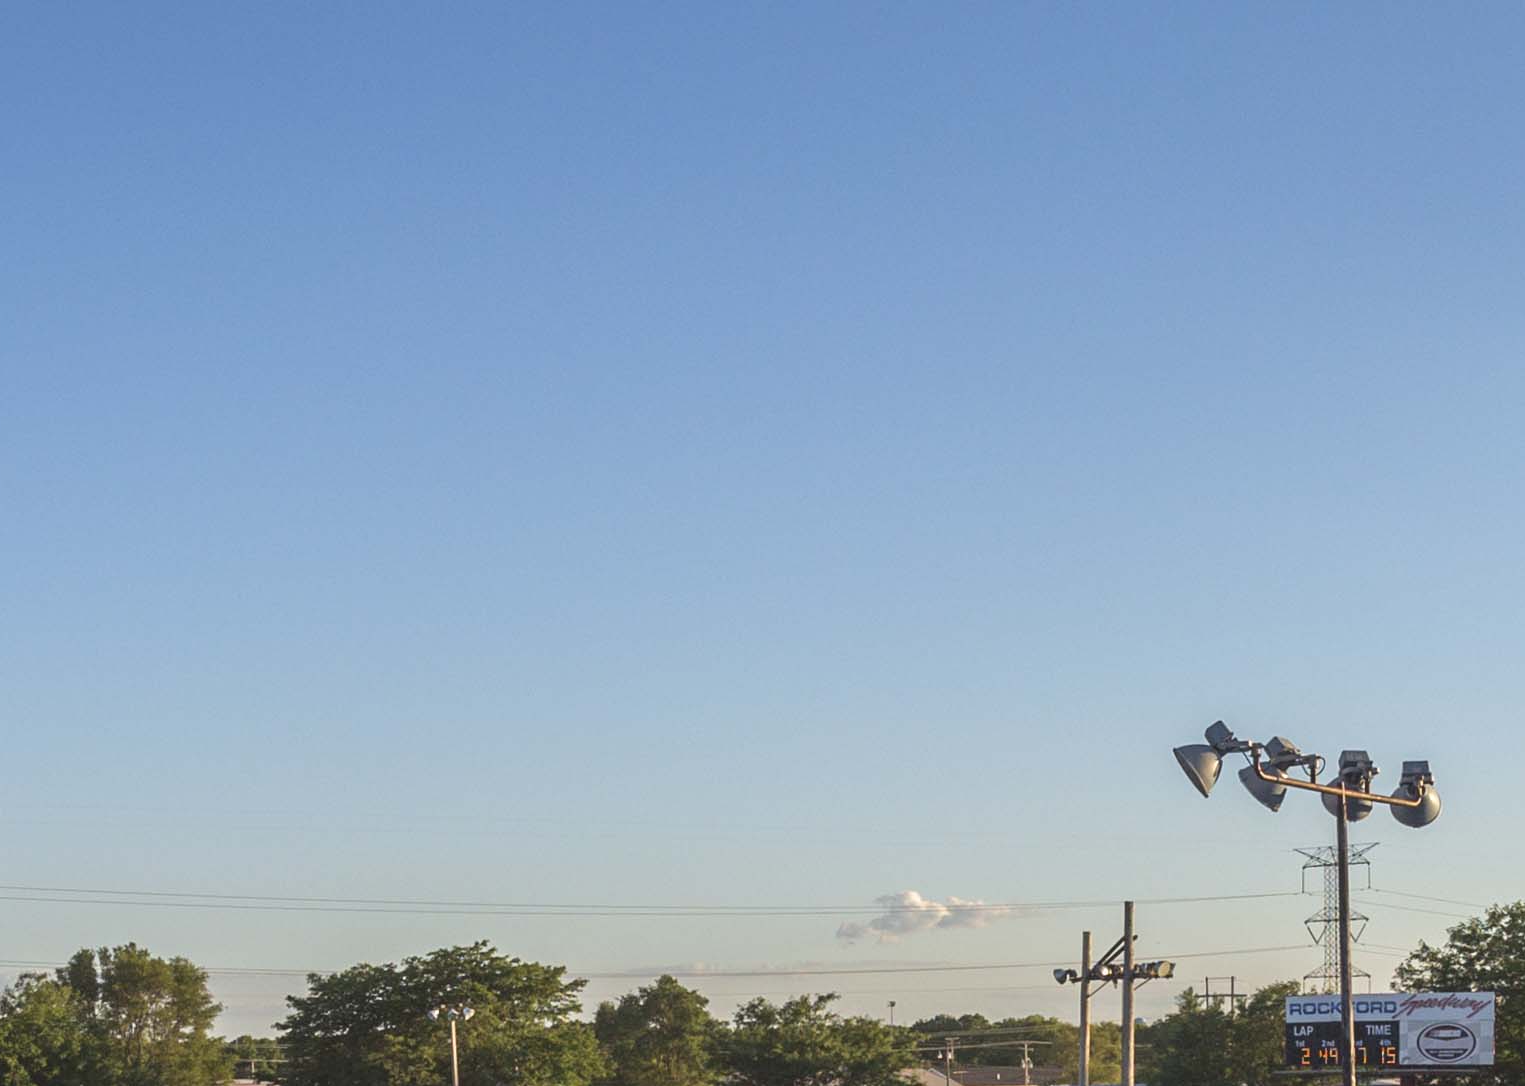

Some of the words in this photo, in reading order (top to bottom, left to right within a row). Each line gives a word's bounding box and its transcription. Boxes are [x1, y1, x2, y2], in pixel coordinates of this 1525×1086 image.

[1289, 1001, 1397, 1015] ROCKORD
[1293, 1026, 1313, 1036] LAP
[1365, 1025, 1392, 1036] TIME
[1380, 1047, 1396, 1064] 15
